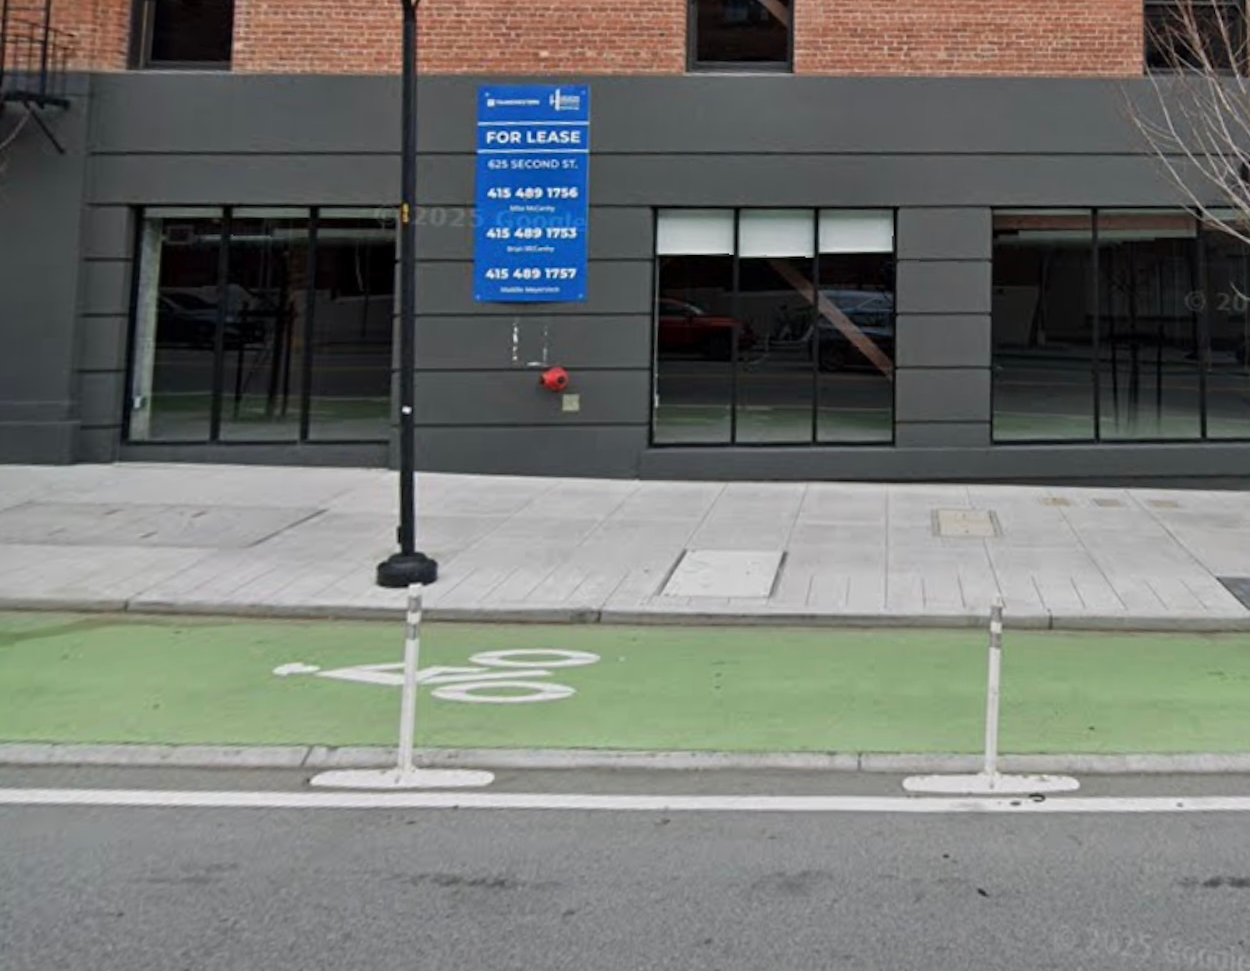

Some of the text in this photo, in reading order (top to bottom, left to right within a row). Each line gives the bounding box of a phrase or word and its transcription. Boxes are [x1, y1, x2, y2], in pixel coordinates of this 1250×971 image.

[486, 130, 581, 144] FOR LEASE
[487, 159, 579, 169] 625 SECOND ST.
[487, 187, 579, 199] 415 489 1756
[486, 227, 577, 239] 415 489 1753
[485, 268, 577, 279] 415 489 1757
